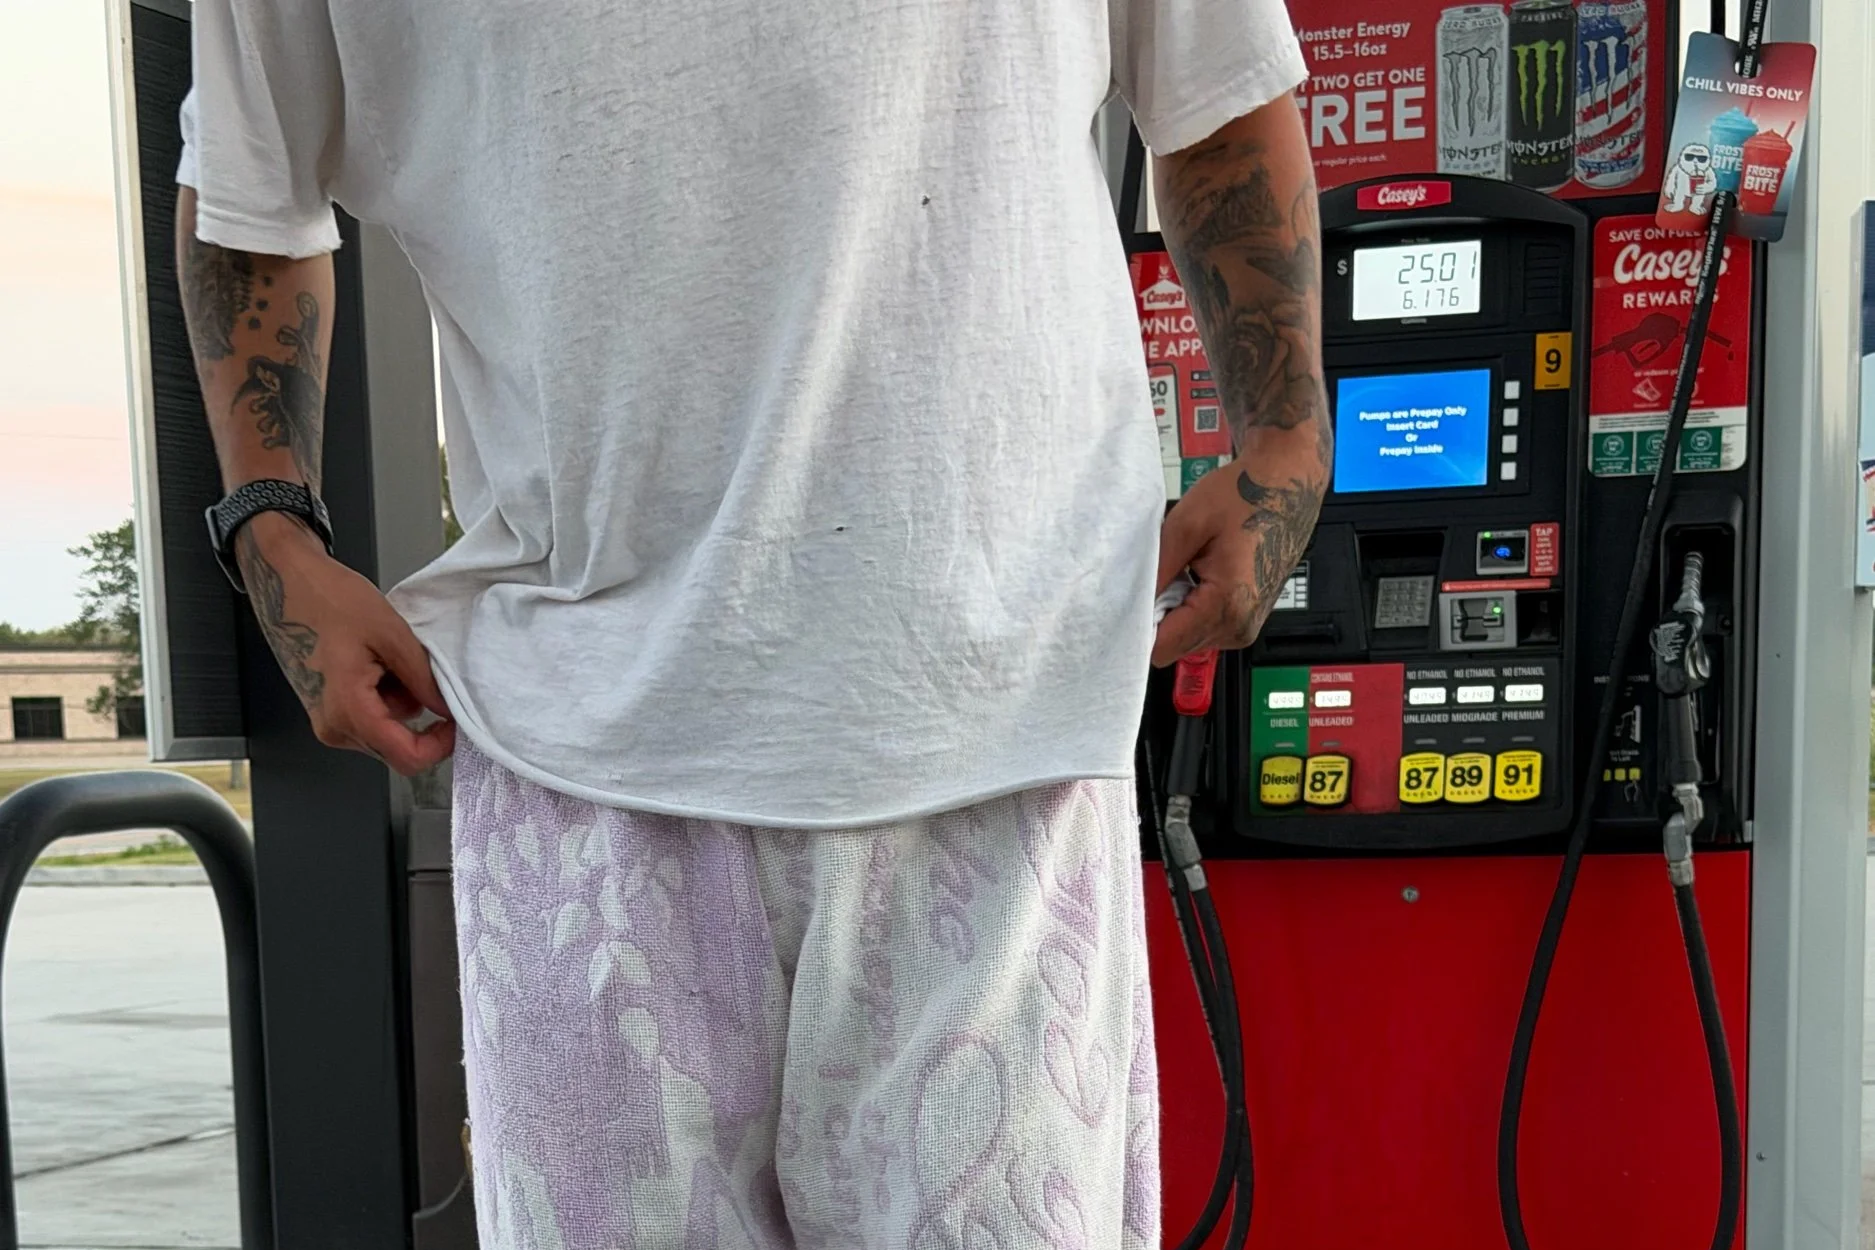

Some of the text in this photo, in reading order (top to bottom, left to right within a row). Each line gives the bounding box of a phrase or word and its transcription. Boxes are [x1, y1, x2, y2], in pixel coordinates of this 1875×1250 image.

[1357, 22, 1411, 38] Energy
[1312, 74, 1349, 91] TWO
[1353, 71, 1385, 87] GET
[1389, 67, 1426, 84] ONE
[1685, 76, 1803, 102] CHILL VIBES ONLY
[1713, 144, 1743, 157] FROST
[1711, 155, 1743, 172] BITE
[1746, 165, 1780, 177] FROST
[1744, 175, 1778, 192] BITE
[1378, 185, 1427, 206] Casey's
[1609, 229, 1642, 243] SAVE
[1644, 228, 1666, 240] ON
[1398, 251, 1477, 284] 25.01
[1403, 287, 1460, 310] 6.176
[1623, 289, 1719, 309] REWAR
[1141, 315, 1196, 335] WNLO
[1545, 349, 1562, 374] 9
[1359, 406, 1467, 421] Pumps are Prepay Only
[1386, 420, 1439, 431] Insert Card
[1405, 433, 1418, 442] Or
[1379, 444, 1443, 456] Prepay Inside
[1535, 528, 1553, 536] TAP
[1419, 670, 1448, 679] ETHANOL
[1465, 668, 1496, 678] ETHANOL
[1514, 666, 1545, 676] ETHANOL
[1270, 718, 1299, 728] DIESEL
[1309, 717, 1353, 727] UNLEADED
[1404, 714, 1449, 724] UNLEADED
[1451, 712, 1498, 722] MIDGRADE
[1502, 711, 1545, 721] PREMIUM
[1262, 773, 1300, 785] Diesel
[1309, 771, 1343, 792] 87
[1405, 767, 1439, 791] 87
[1451, 765, 1483, 788] 89
[1503, 763, 1533, 787] 91
